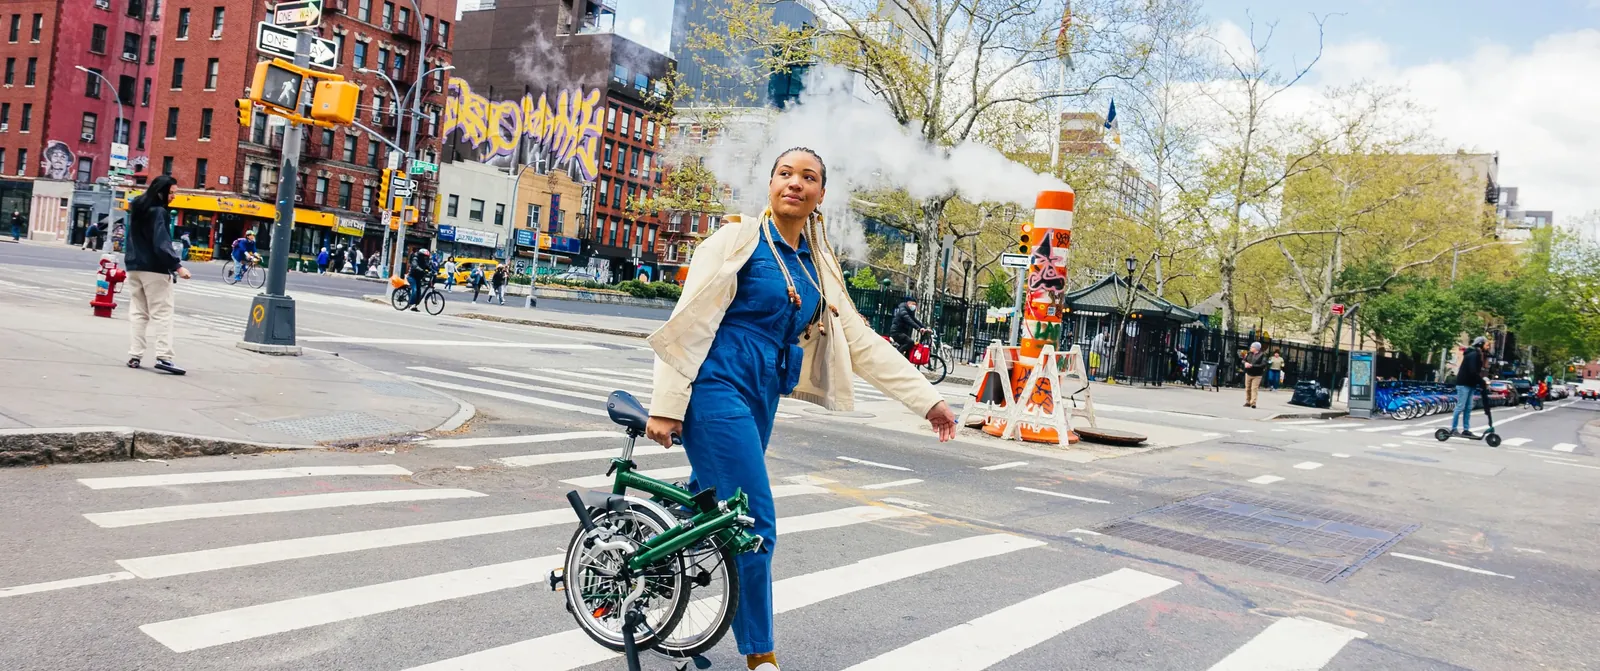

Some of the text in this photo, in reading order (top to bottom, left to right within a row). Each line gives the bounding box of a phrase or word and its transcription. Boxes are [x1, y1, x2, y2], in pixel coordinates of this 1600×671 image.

[279, 8, 313, 21] ONE WAY
[266, 33, 289, 48] ONE
